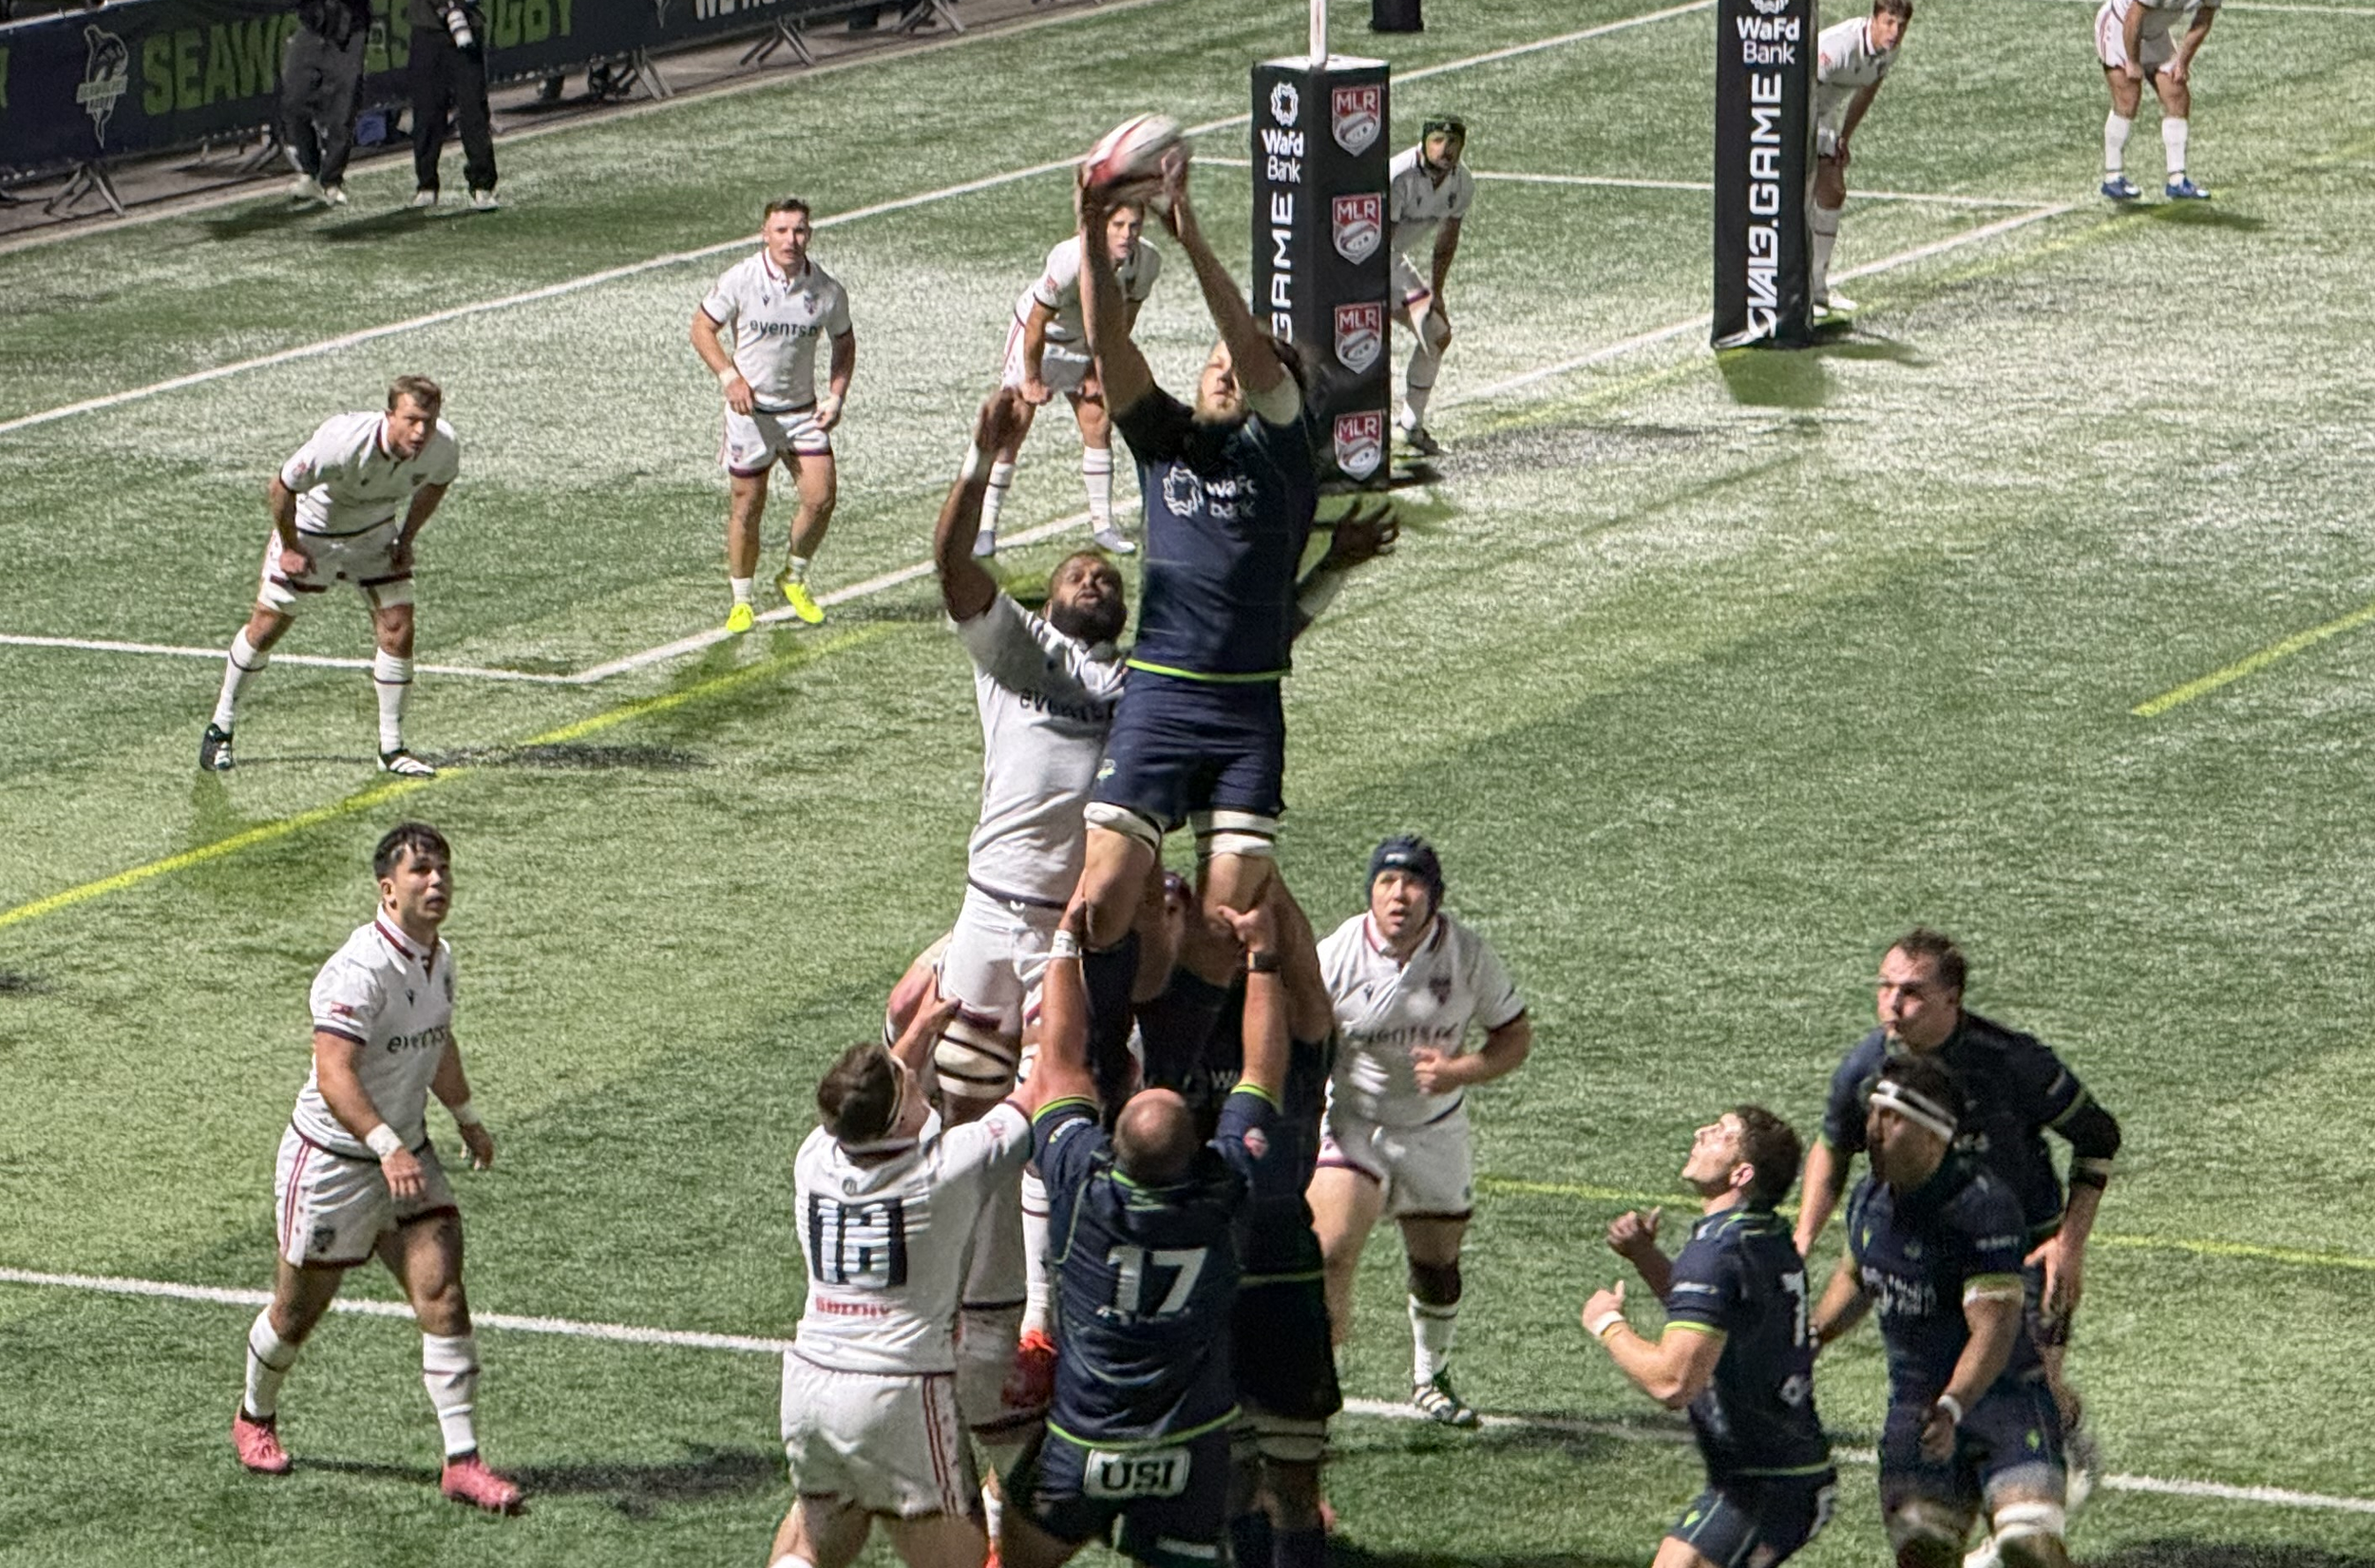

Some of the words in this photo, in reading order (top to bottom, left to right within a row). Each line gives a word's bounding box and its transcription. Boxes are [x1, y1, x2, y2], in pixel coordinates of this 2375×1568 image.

[1736, 15, 1800, 41] WaFd
[1743, 40, 1796, 66] Bank
[1337, 91, 1377, 112] MLR
[1262, 129, 1304, 156] WaFd
[1267, 156, 1302, 184] Bank
[1338, 199, 1377, 221] MLR
[1339, 309, 1378, 330] MLR
[1339, 419, 1378, 440] MLR
[1106, 1244, 1209, 1313] 17
[1101, 1460, 1177, 1492] USI
